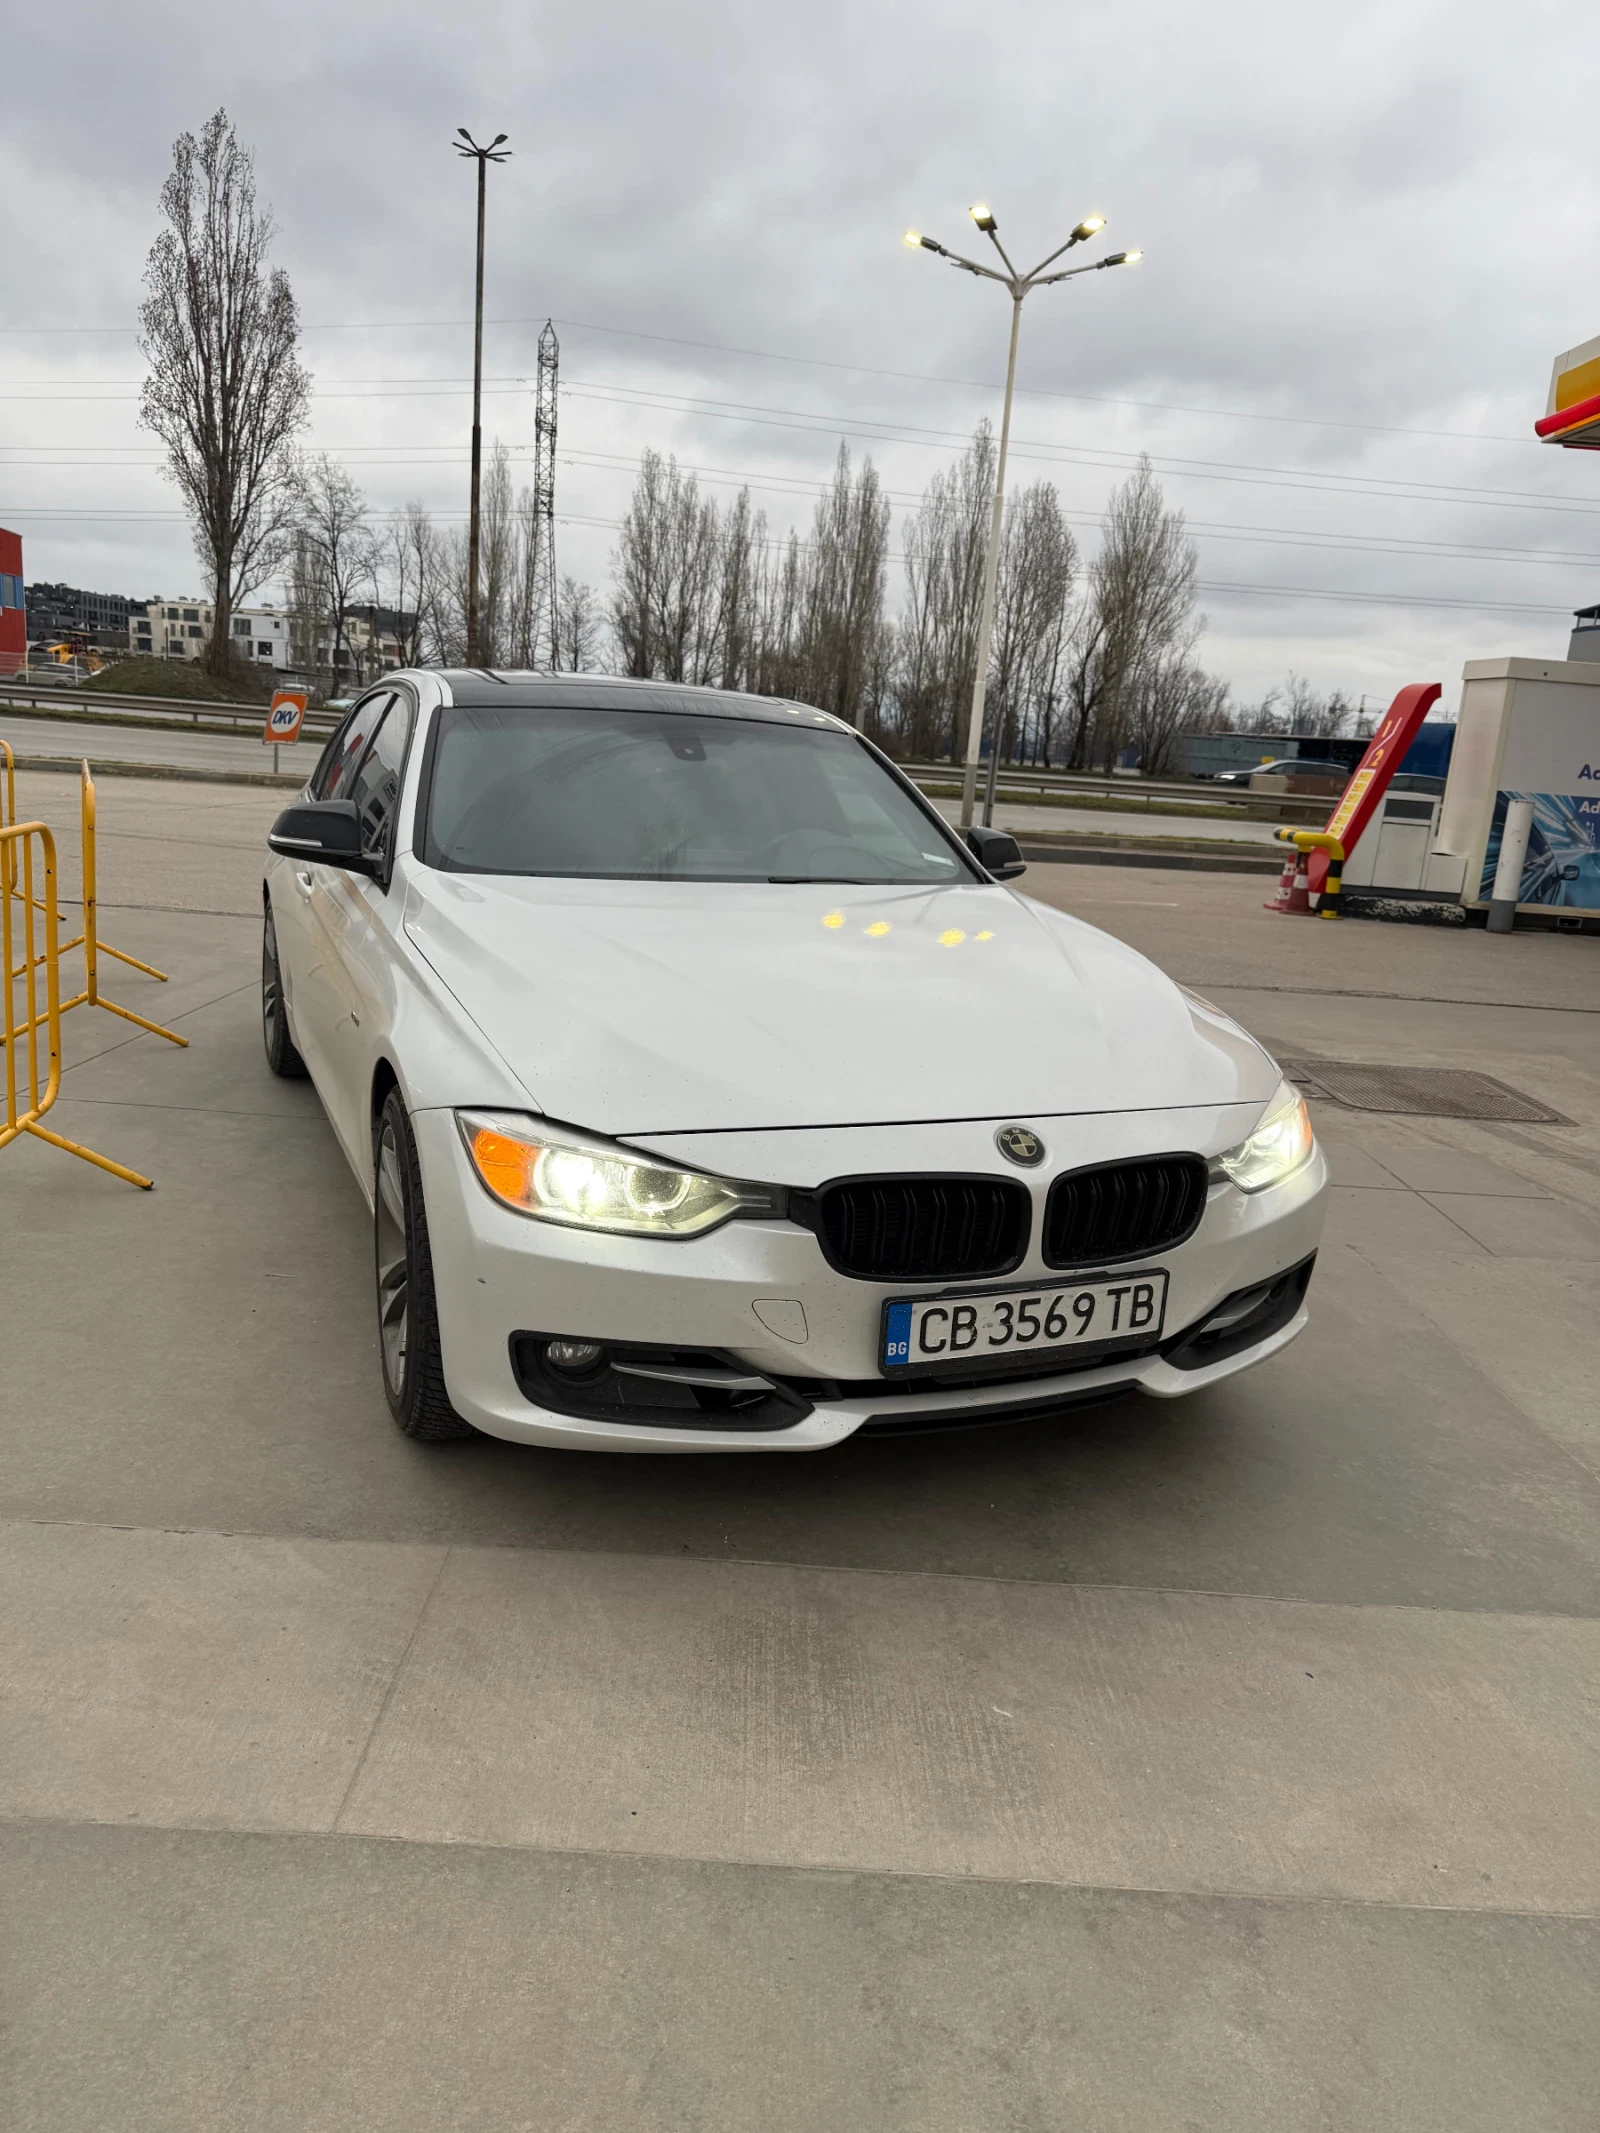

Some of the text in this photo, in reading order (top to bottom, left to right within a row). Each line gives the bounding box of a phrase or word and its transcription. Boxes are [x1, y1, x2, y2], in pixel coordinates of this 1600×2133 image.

[272, 710, 298, 724] DKV
[1381, 720, 1392, 738] 1
[1370, 748, 1384, 767] 2
[919, 1284, 1154, 1354] CB 3569 TB
[887, 1342, 907, 1356] BG
